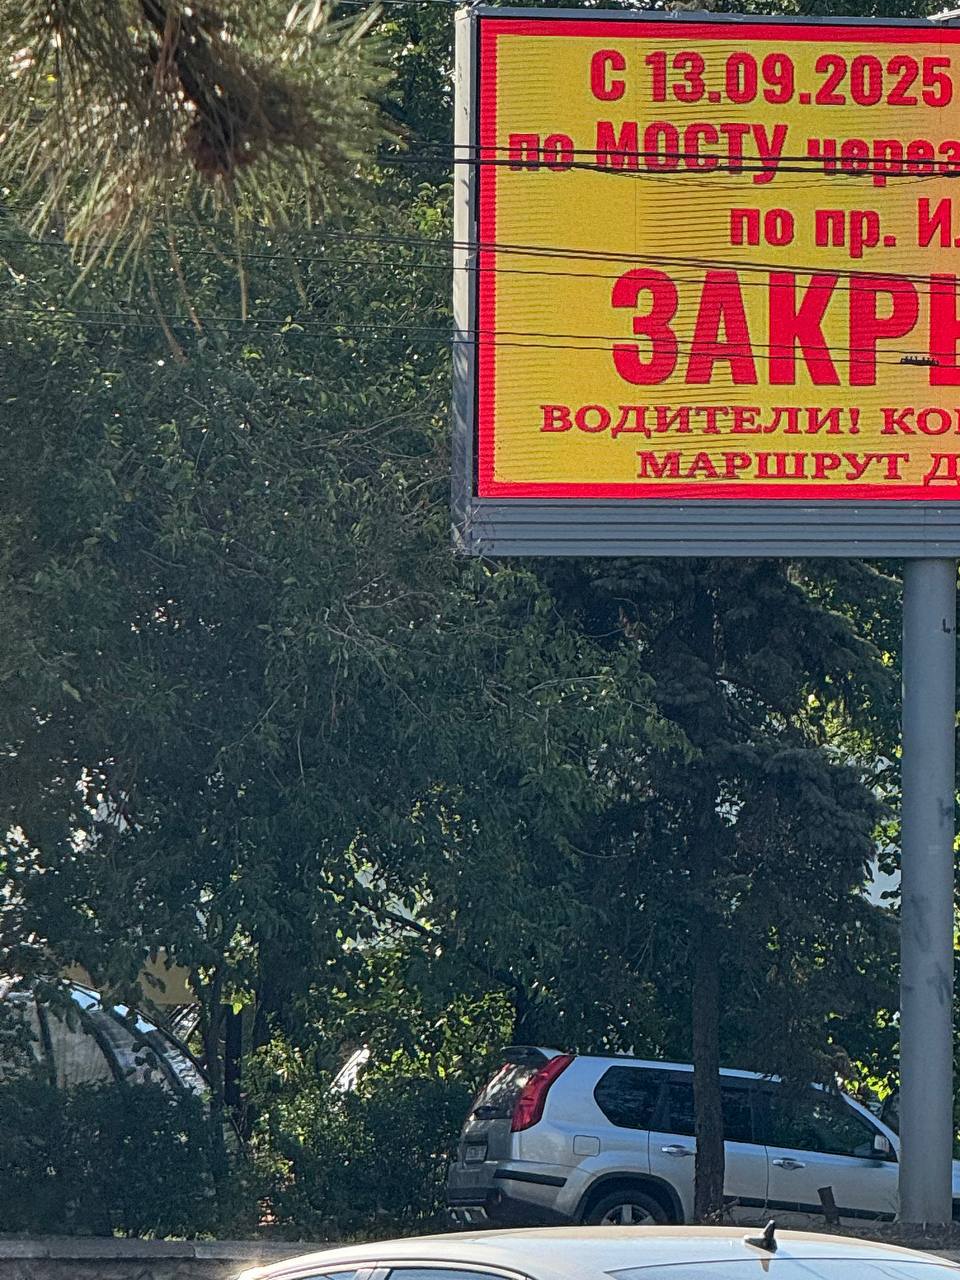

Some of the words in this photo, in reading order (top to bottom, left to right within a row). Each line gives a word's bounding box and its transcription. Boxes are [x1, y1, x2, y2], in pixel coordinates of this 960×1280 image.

[590, 49, 626, 102] С
[645, 51, 954, 108] 13.09.2025
[508, 133, 574, 172] по
[596, 121, 788, 185] МОСТУ
[730, 208, 794, 246] по
[815, 209, 897, 258] пр.
[540, 404, 860, 438] ВОДИТЕЛИ!
[637, 450, 910, 480] МАРШРУТ
